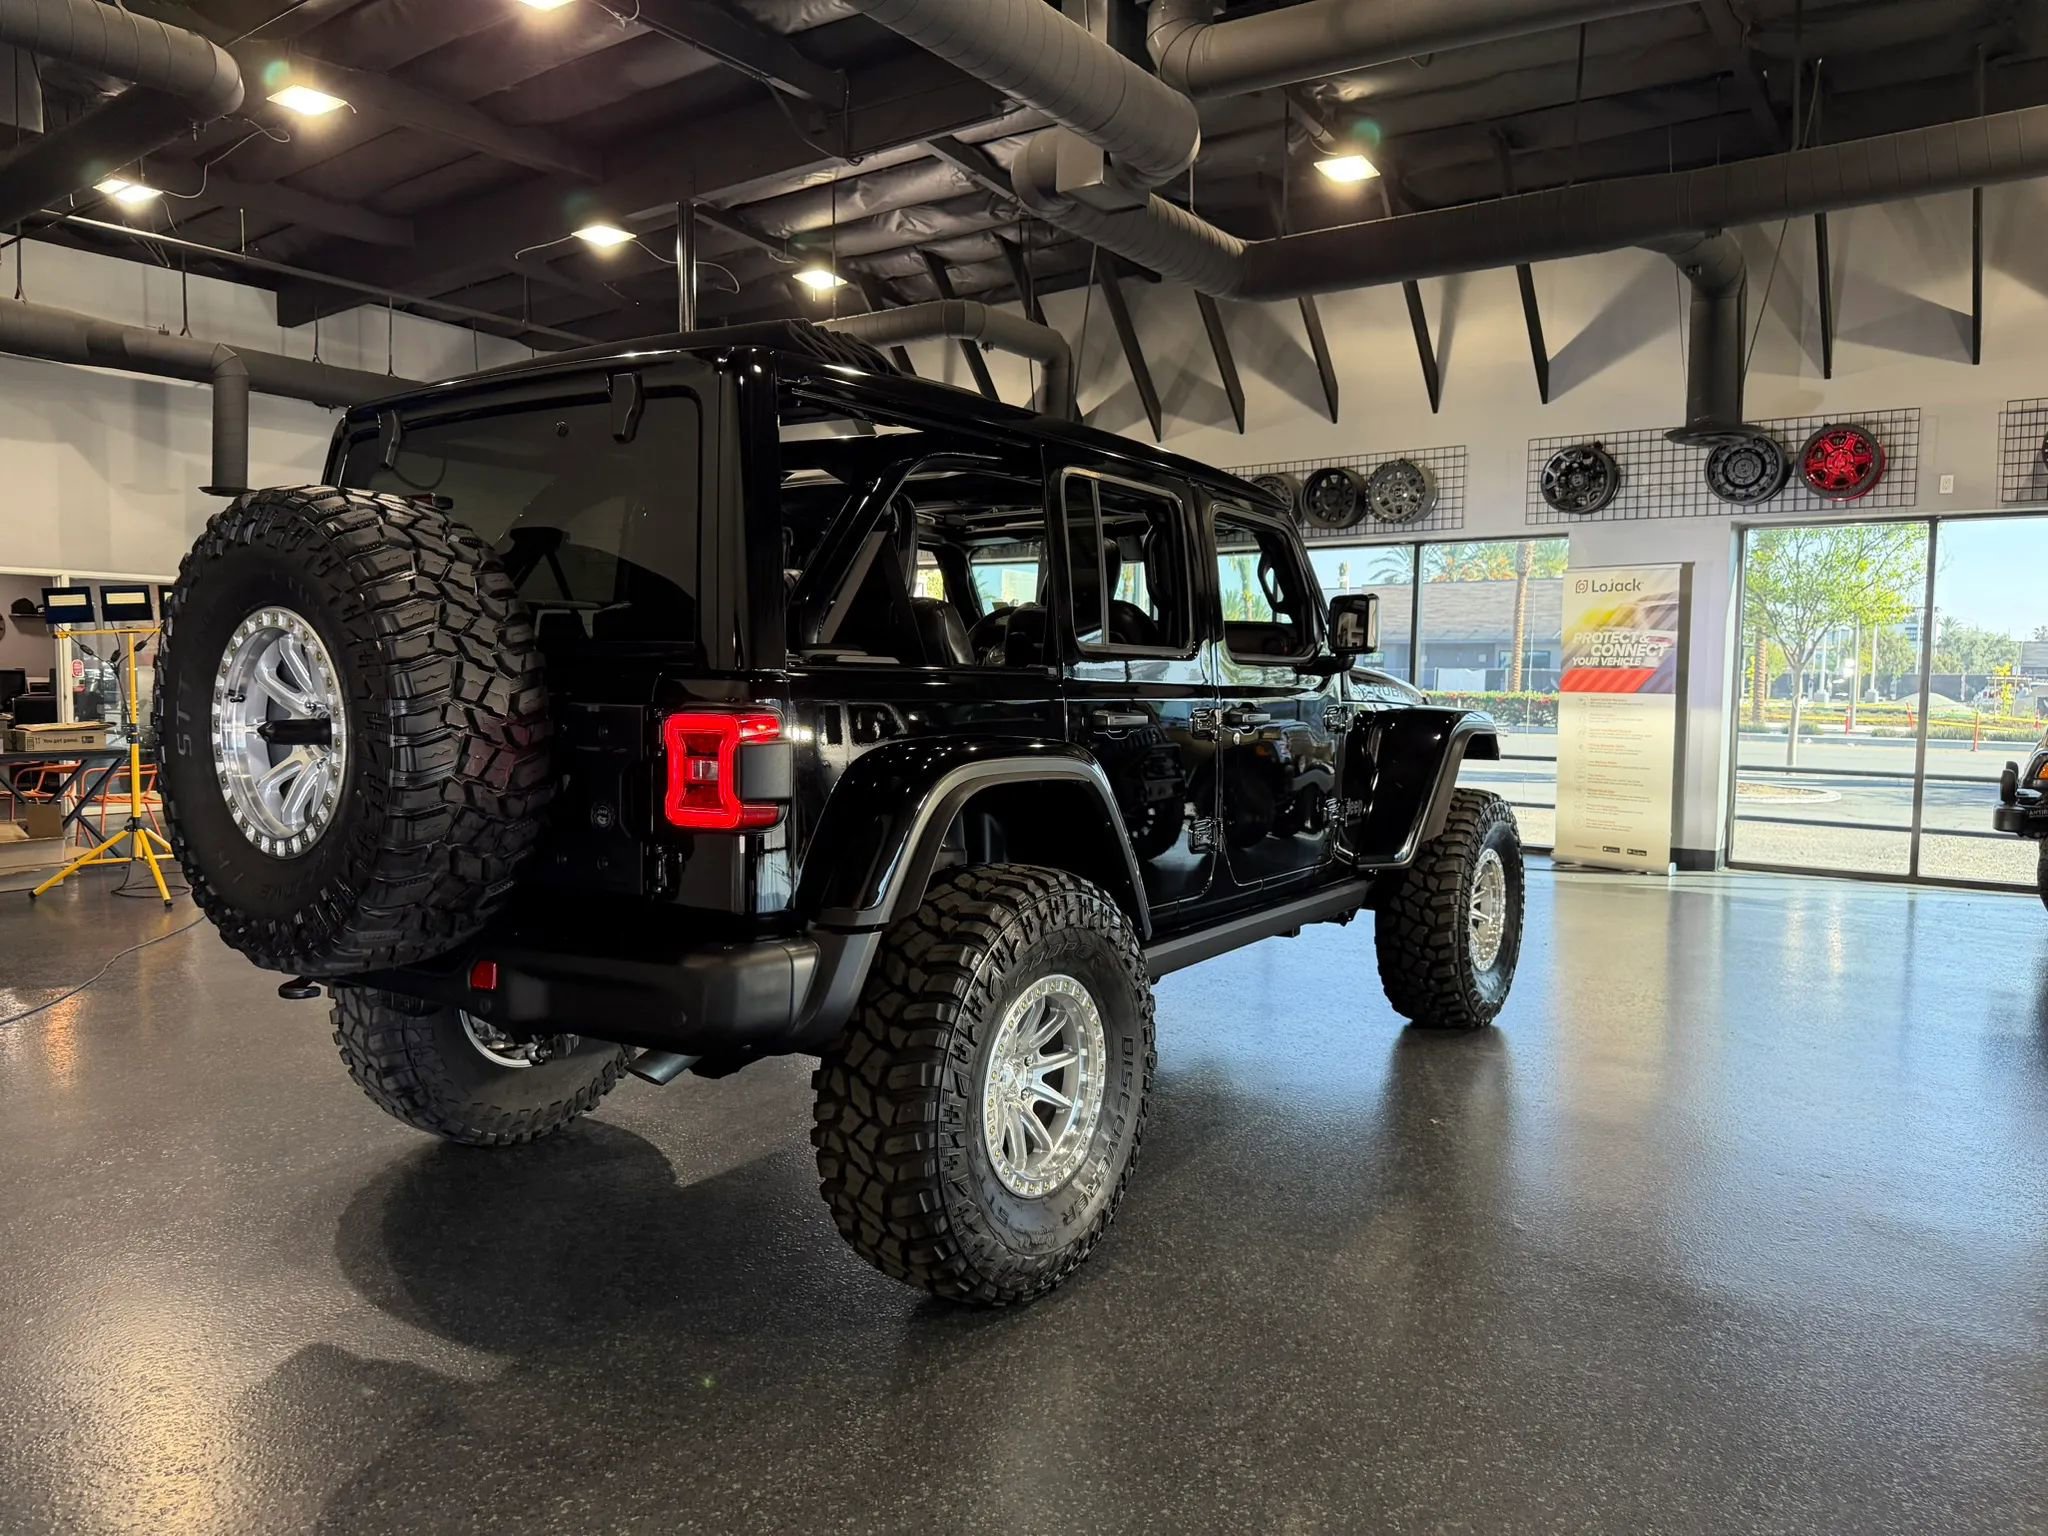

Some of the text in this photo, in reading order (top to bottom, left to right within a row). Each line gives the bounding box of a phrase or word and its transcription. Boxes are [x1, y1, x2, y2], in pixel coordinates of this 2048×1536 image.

[1573, 631, 1650, 644] PROTECT &
[1590, 643, 1665, 657] CONNECT
[1572, 657, 1642, 666] YOUR VEHICLE
[1062, 1035, 1135, 1227] DISCOVERER
